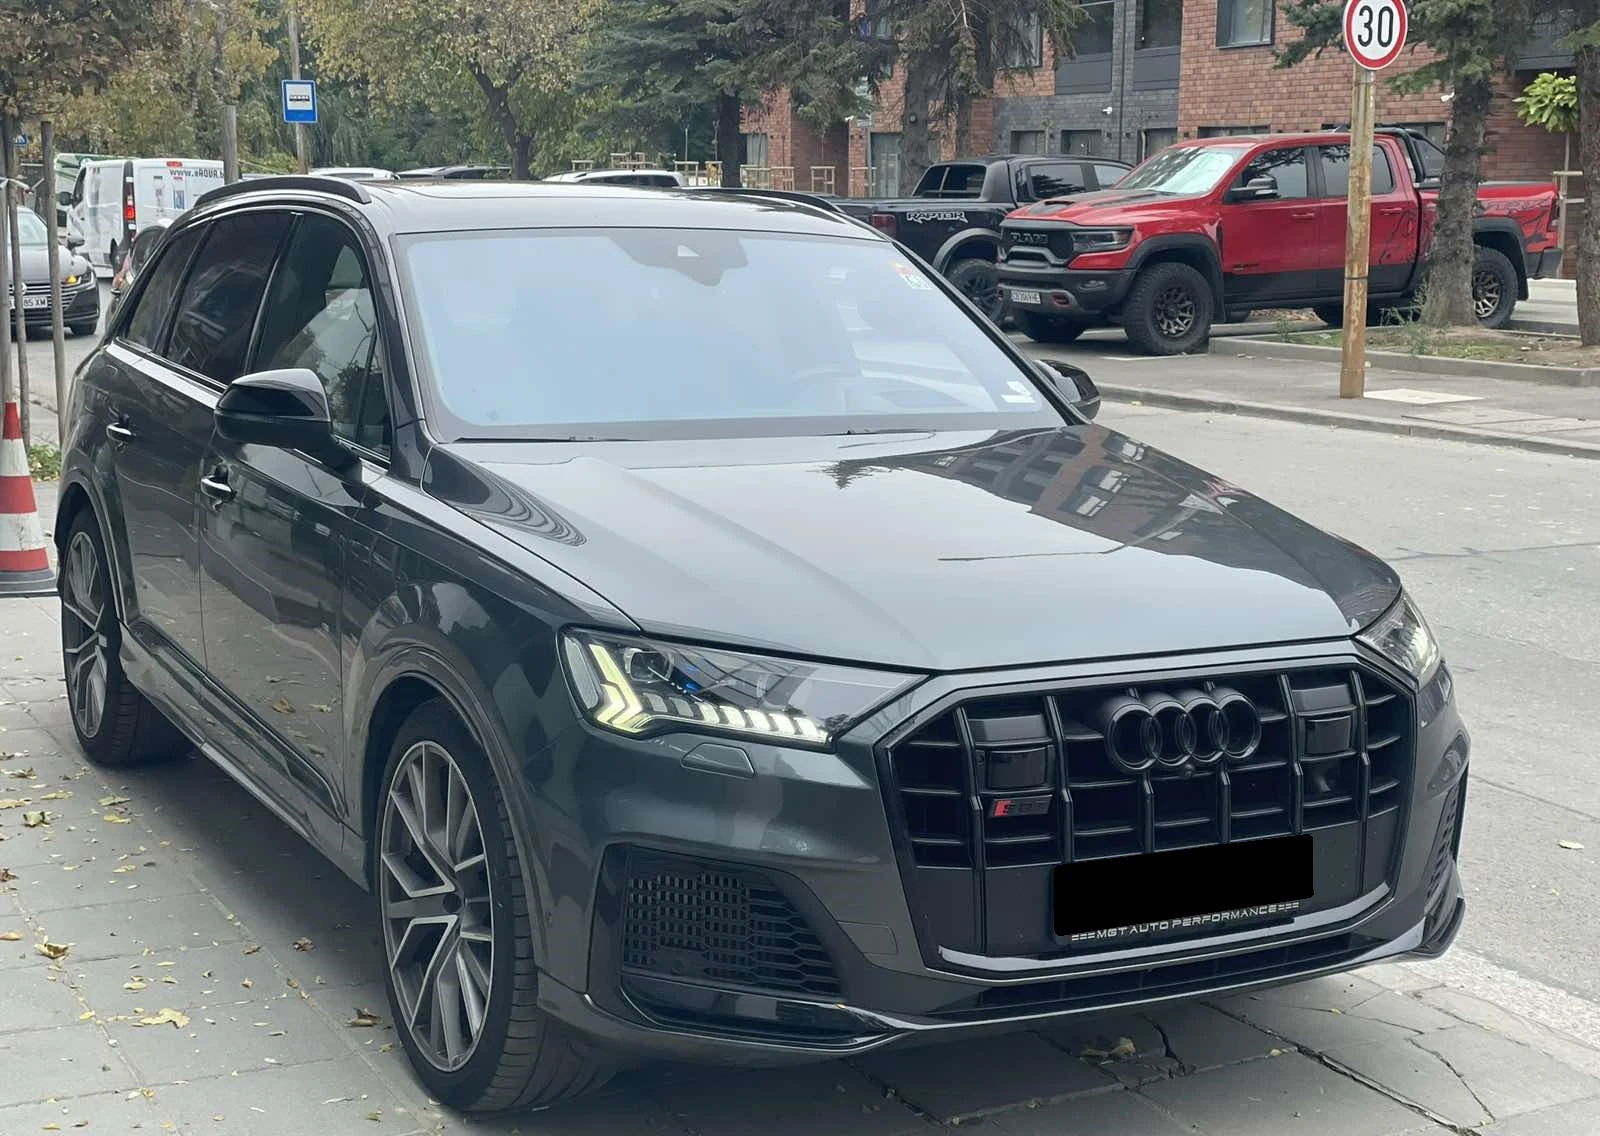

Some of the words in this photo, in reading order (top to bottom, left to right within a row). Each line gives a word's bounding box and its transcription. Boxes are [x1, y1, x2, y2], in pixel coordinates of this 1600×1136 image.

[1357, 5, 1394, 48] 30
[906, 211, 969, 224] RAPTOR
[1096, 926, 1128, 941] MGT
[1128, 920, 1169, 935] AUTO
[1171, 904, 1278, 930] PERFORMANCE
